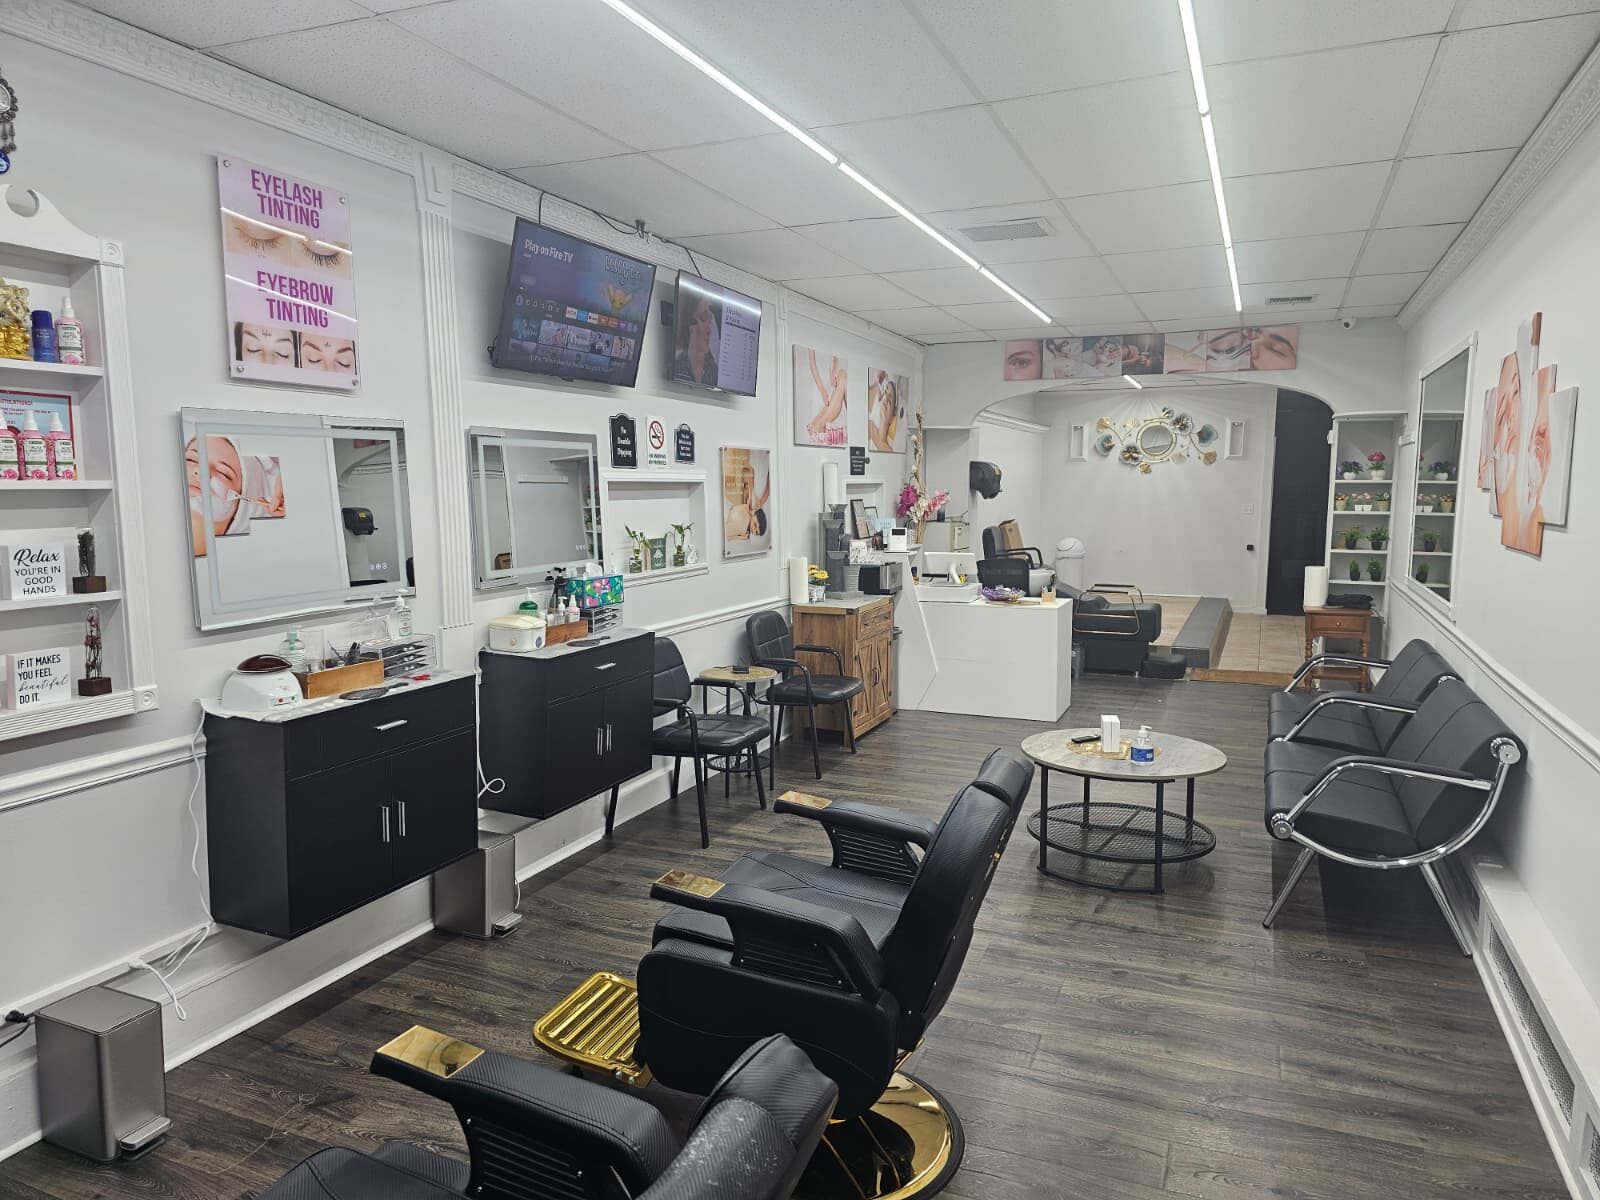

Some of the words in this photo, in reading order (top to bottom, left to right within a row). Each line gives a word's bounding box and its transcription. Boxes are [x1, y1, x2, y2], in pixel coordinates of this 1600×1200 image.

[250, 169, 323, 210] EYELASH
[257, 193, 320, 229] TINTING
[524, 239, 539, 255] Play
[540, 246, 549, 256] on
[549, 246, 562, 259] Fire
[563, 251, 574, 263] TV
[257, 270, 334, 305] EYEBROW
[266, 298, 329, 328] TINTING
[13, 548, 60, 567] Relax
[14, 566, 48, 576] YOU'RE
[51, 565, 61, 573] IN
[23, 585, 56, 595] HANDS
[25, 576, 53, 586] GOOD
[17, 659, 25, 669] IF
[26, 658, 34, 667] IT
[36, 654, 61, 667] MAKES
[18, 670, 33, 681] YOU
[35, 667, 52, 679] FEEL
[18, 674, 69, 692] beautiful
[19, 694, 30, 704] DO
